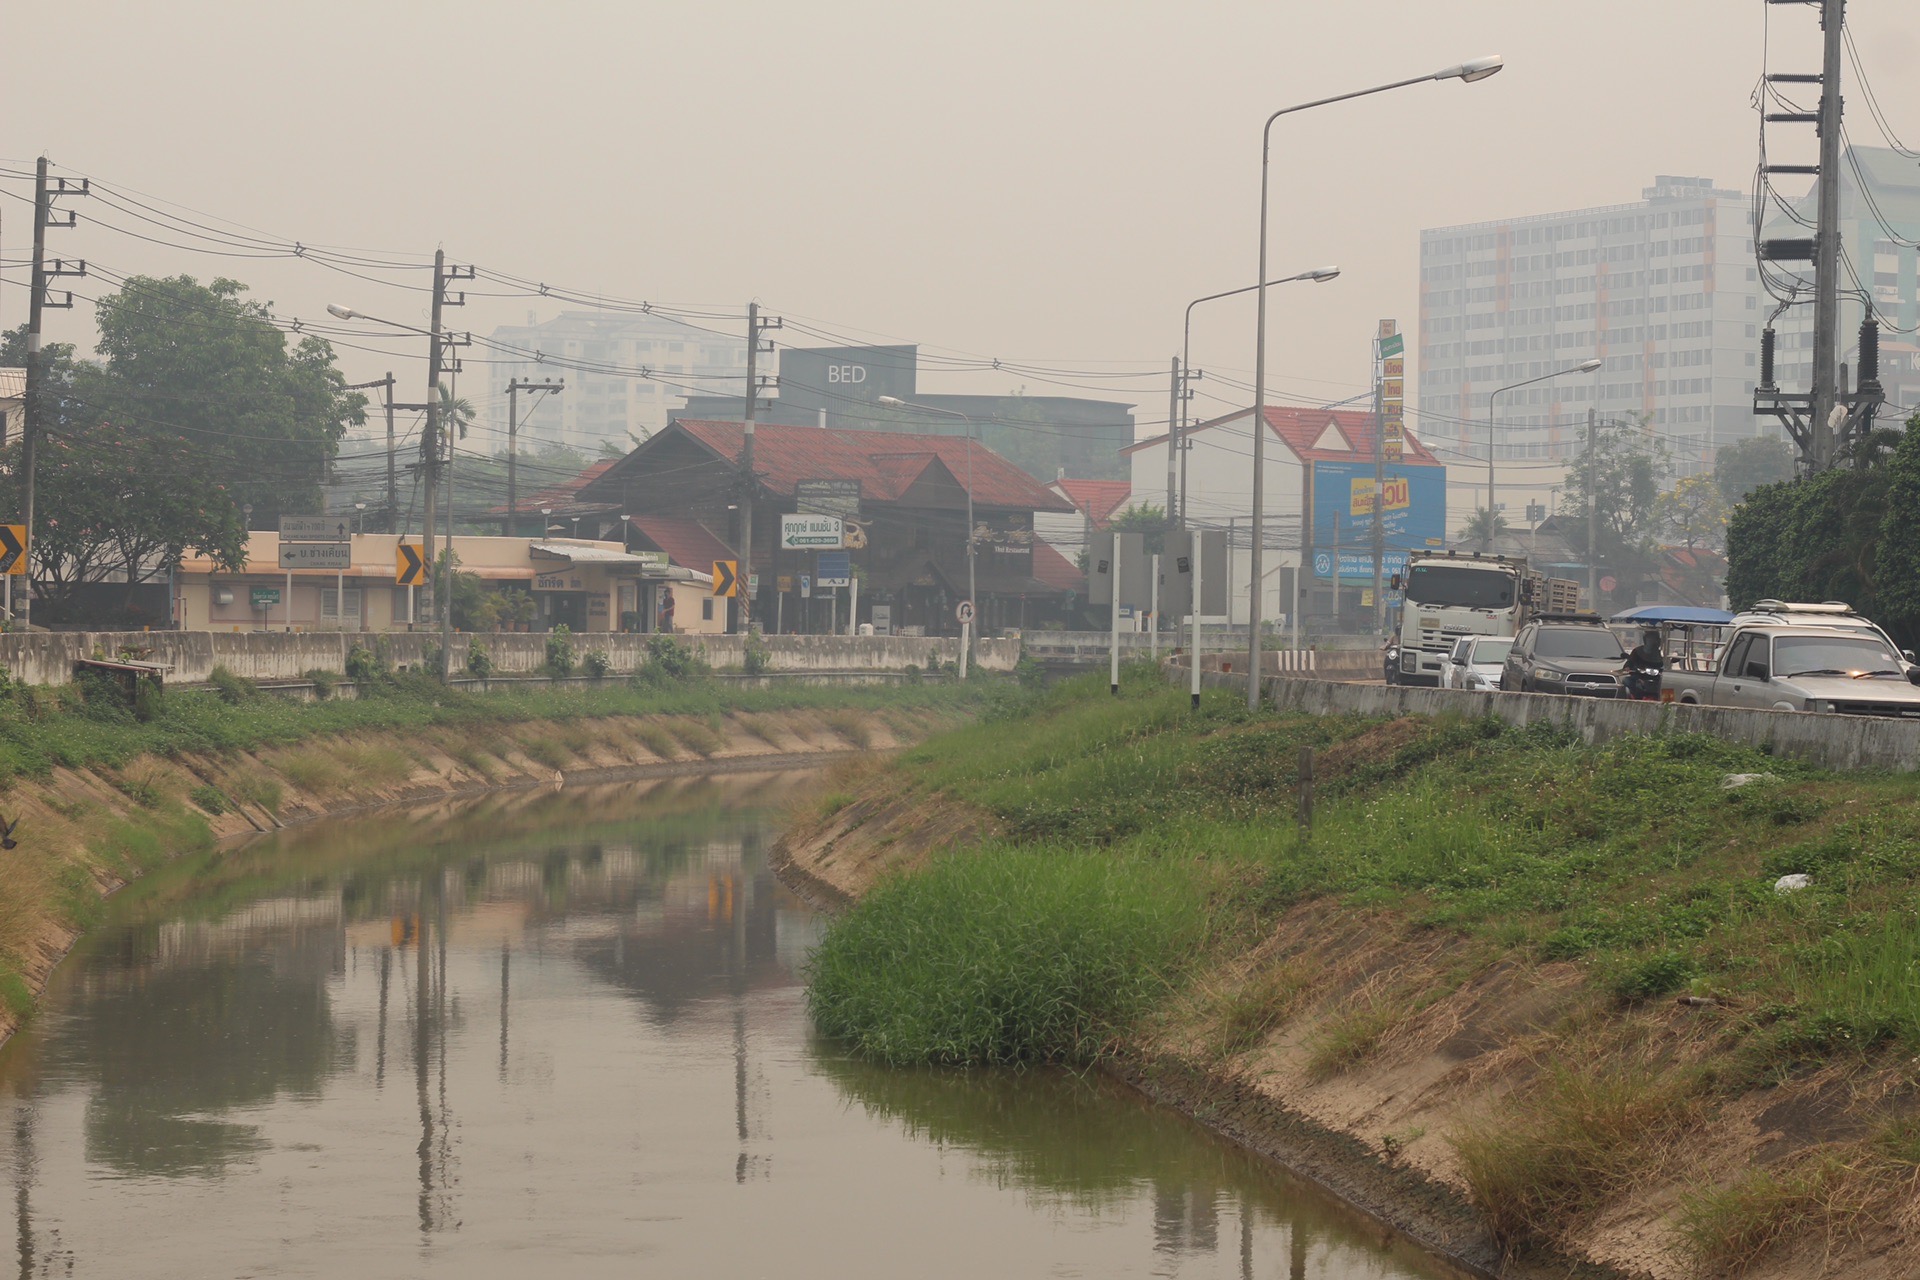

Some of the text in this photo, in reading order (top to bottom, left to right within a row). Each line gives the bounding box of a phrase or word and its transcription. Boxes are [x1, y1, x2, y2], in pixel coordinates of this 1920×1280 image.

[829, 365, 867, 383] BED
[1386, 383, 1401, 396] ไทย
[834, 521, 840, 532] 3
[994, 545, 1005, 553] Thai
[1444, 623, 1472, 632] ISUZU
